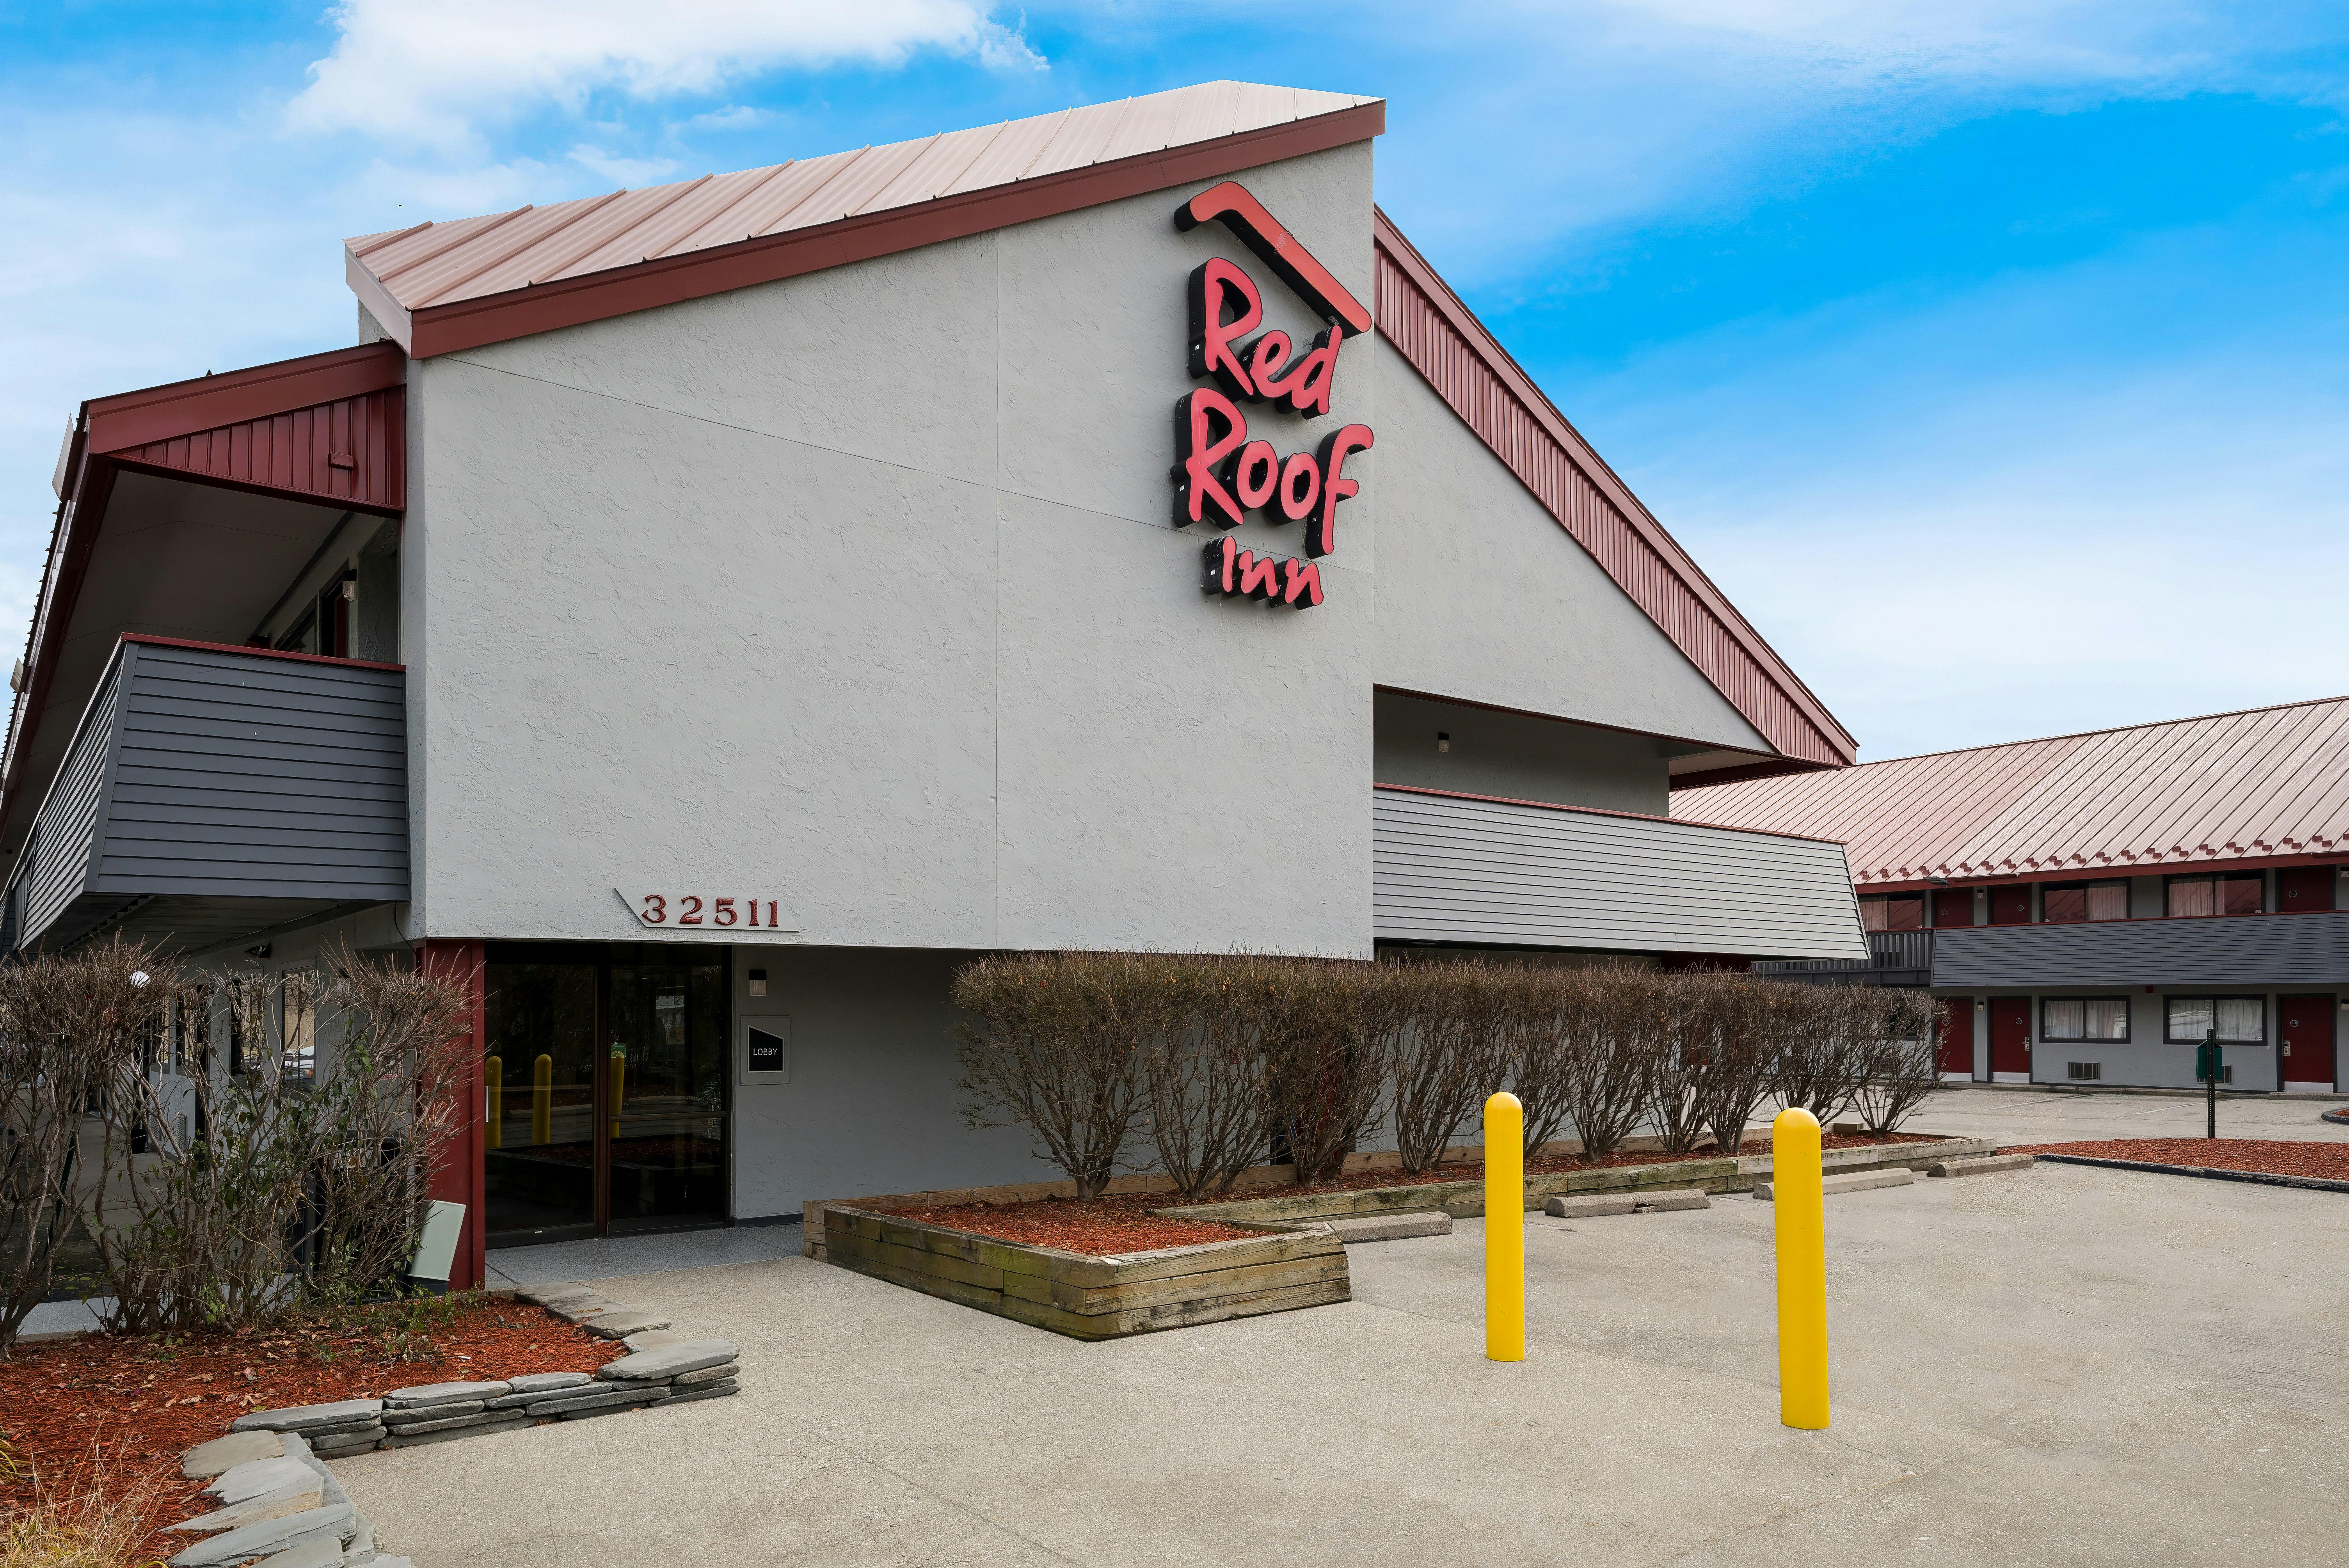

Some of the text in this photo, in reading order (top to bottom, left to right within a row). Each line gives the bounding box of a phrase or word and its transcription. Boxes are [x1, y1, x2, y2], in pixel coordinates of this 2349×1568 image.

[1205, 257, 1343, 415] Red
[1185, 387, 1374, 555] Roof
[1222, 536, 1324, 606] Inn
[641, 895, 779, 927] 32511
